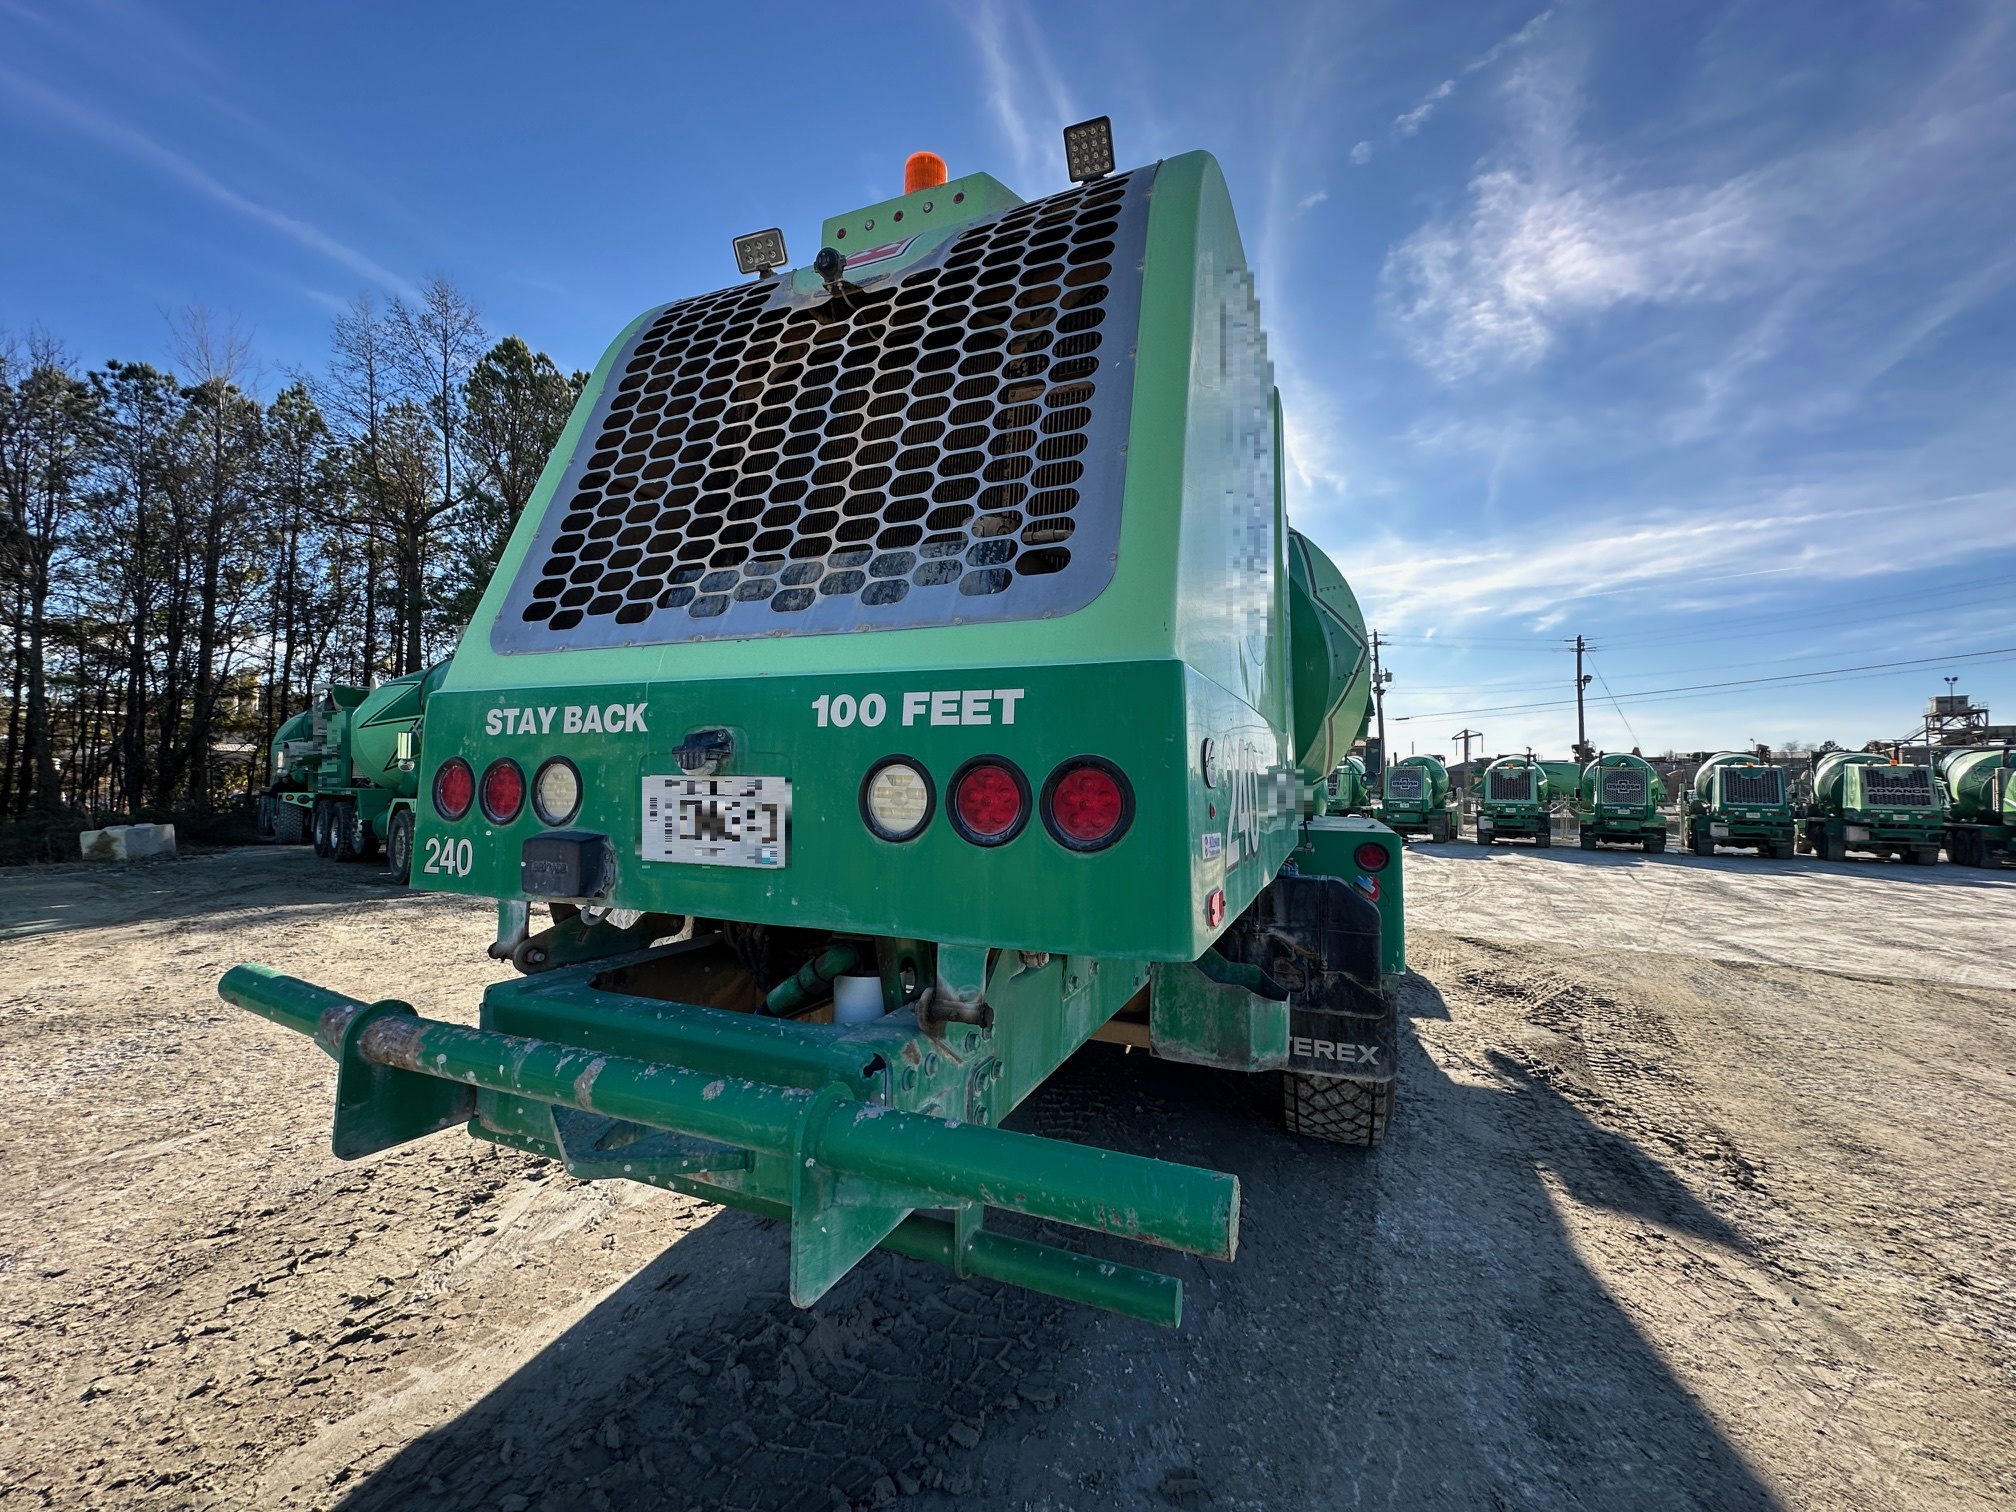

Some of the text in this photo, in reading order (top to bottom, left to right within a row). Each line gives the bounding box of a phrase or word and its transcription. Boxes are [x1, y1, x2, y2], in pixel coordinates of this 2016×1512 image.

[485, 703, 648, 735] STAY BACK
[812, 688, 1025, 727] 100 FEET
[1222, 734, 1260, 871] 240
[423, 837, 473, 877] 240
[1290, 1036, 1380, 1065] EREX
